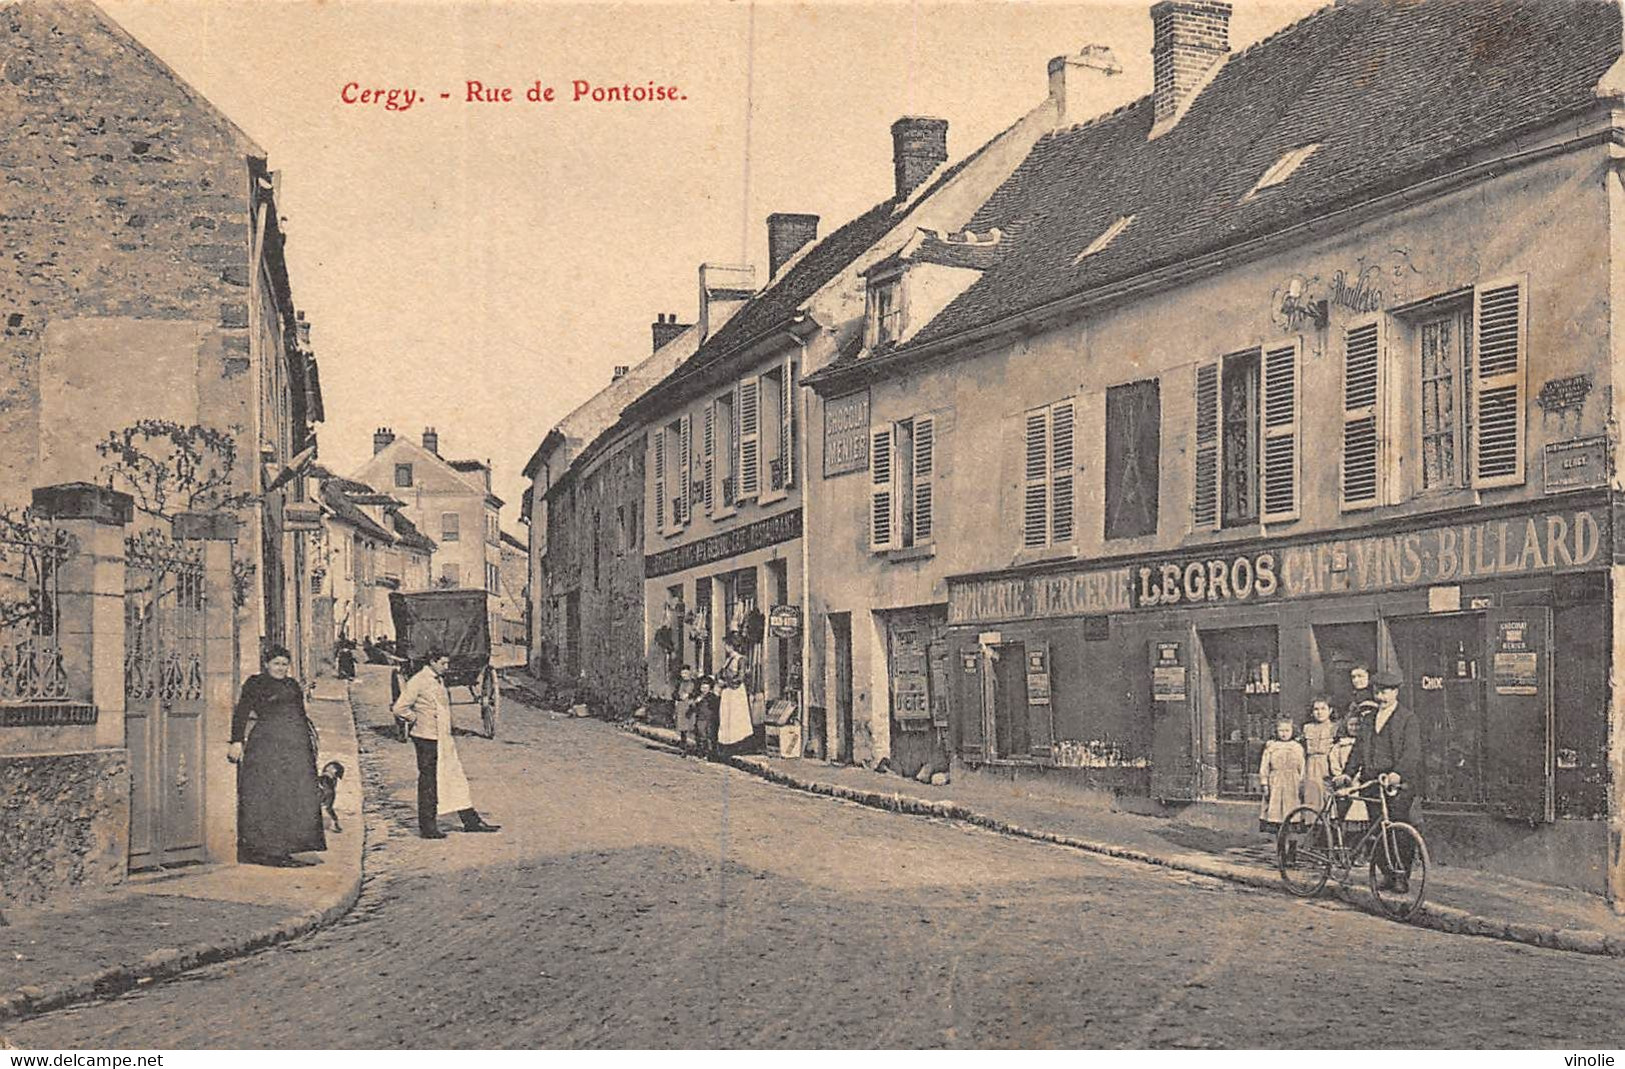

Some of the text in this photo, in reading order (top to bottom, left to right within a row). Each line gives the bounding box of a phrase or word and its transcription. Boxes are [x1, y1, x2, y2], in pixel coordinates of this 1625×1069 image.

[827, 402, 868, 434] CHOCOLAT
[827, 434, 866, 465] MENIER
[1031, 567, 1131, 618] MERCERIE
[1139, 553, 1277, 606] LEGROS
[1354, 534, 1422, 592] VINS
[1436, 511, 1599, 582] BILLARD
